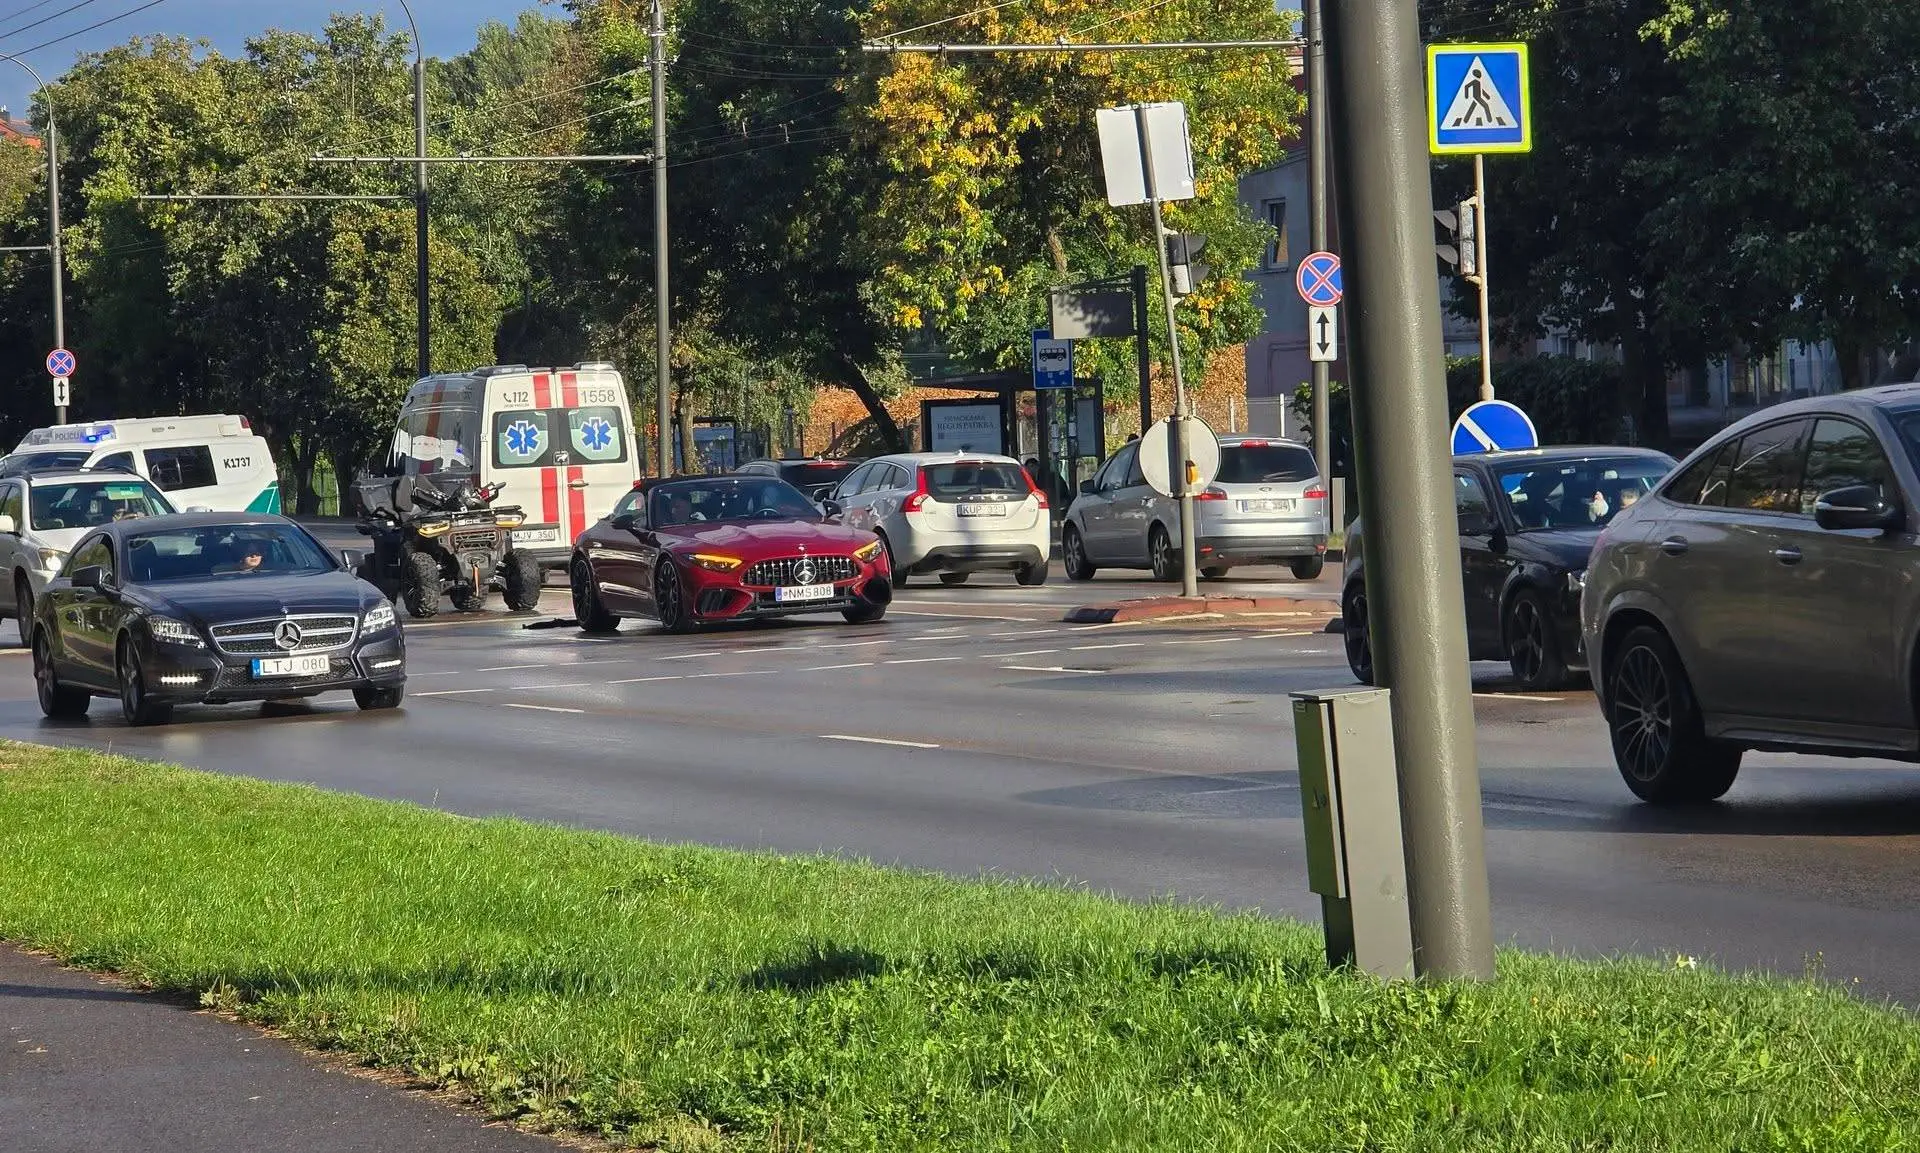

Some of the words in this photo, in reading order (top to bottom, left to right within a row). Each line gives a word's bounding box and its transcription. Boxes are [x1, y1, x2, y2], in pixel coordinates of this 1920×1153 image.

[513, 391, 529, 403] 112
[581, 389, 616, 403] 1558
[223, 456, 250, 469] K1737
[962, 504, 982, 514] KUP
[262, 659, 293, 674] LTJ
[302, 657, 326, 671] 080
